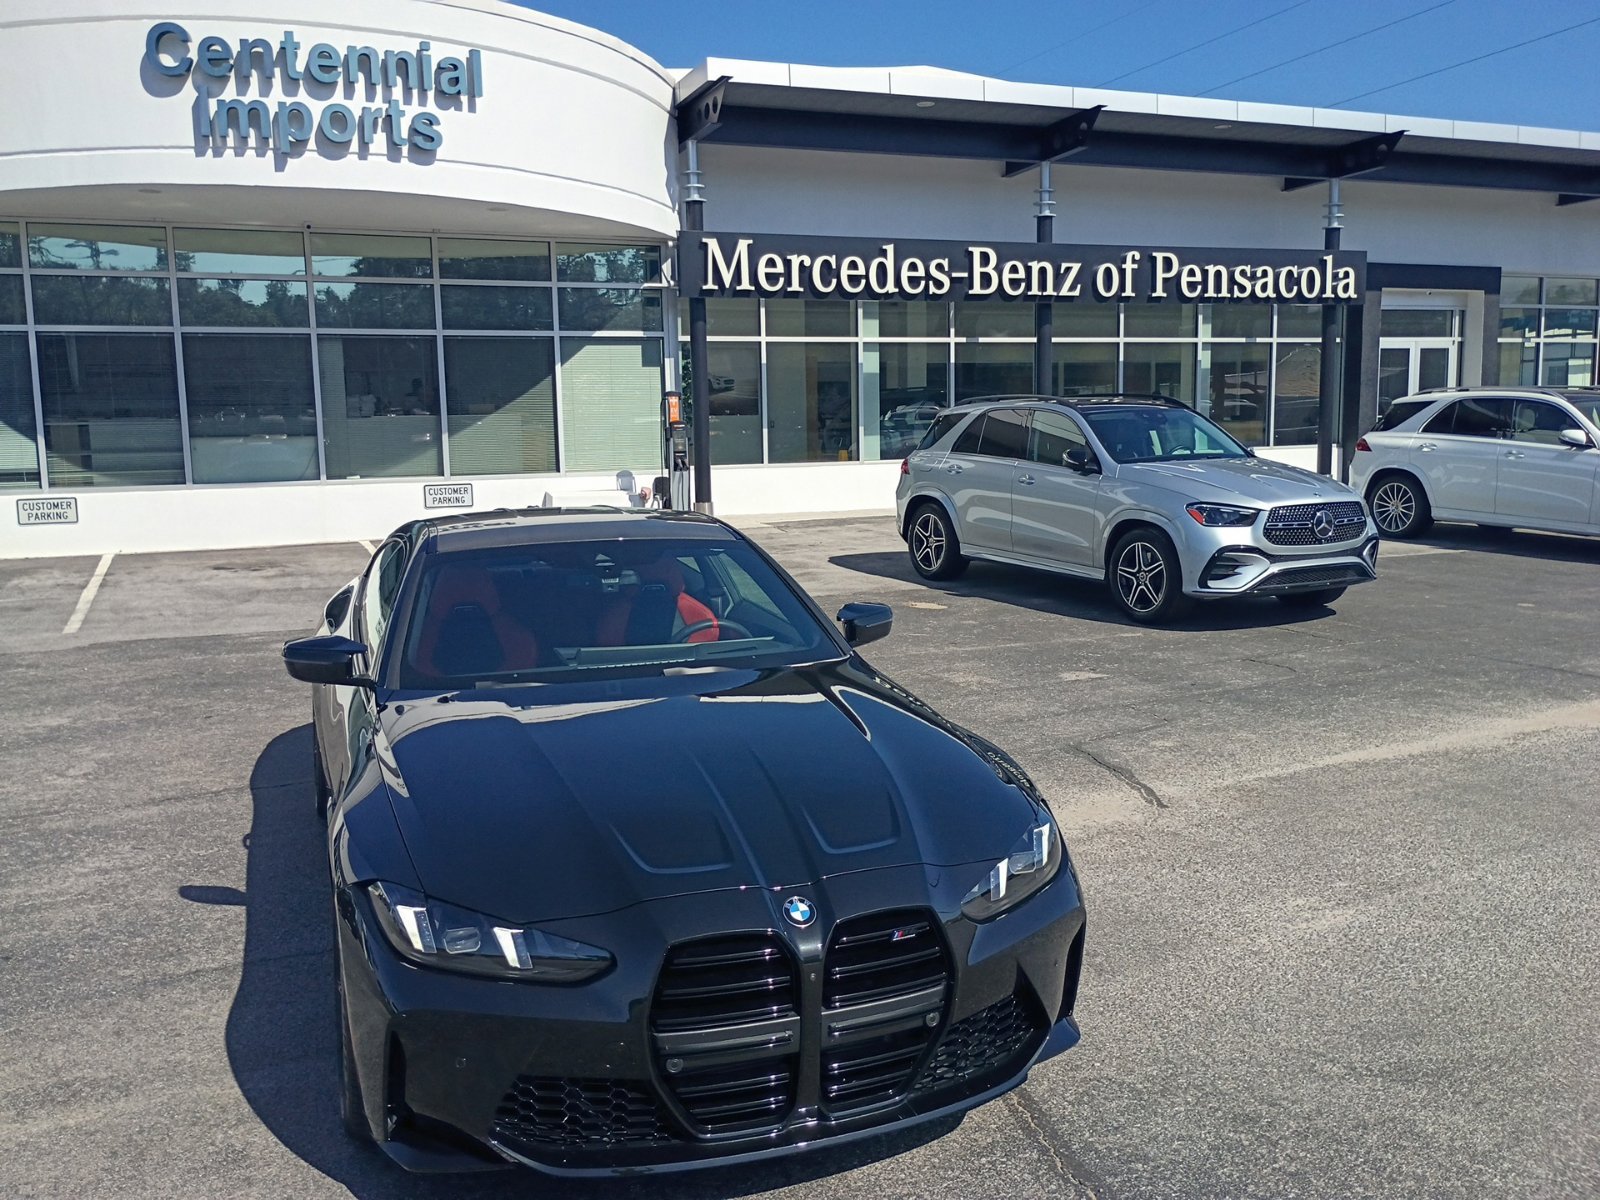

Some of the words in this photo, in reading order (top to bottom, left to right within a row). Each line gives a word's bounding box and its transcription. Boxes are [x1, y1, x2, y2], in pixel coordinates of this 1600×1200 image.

[145, 21, 483, 98] Centennial
[200, 86, 443, 154] Imports
[701, 237, 1082, 298] Mercedes-Benz
[1095, 250, 1141, 298] of
[1151, 251, 1358, 299] Pensacola
[427, 486, 469, 496] CUSTOMER
[432, 495, 466, 505] PARKING
[22, 501, 72, 512] CUSTOMER
[27, 511, 69, 521] PARKING
